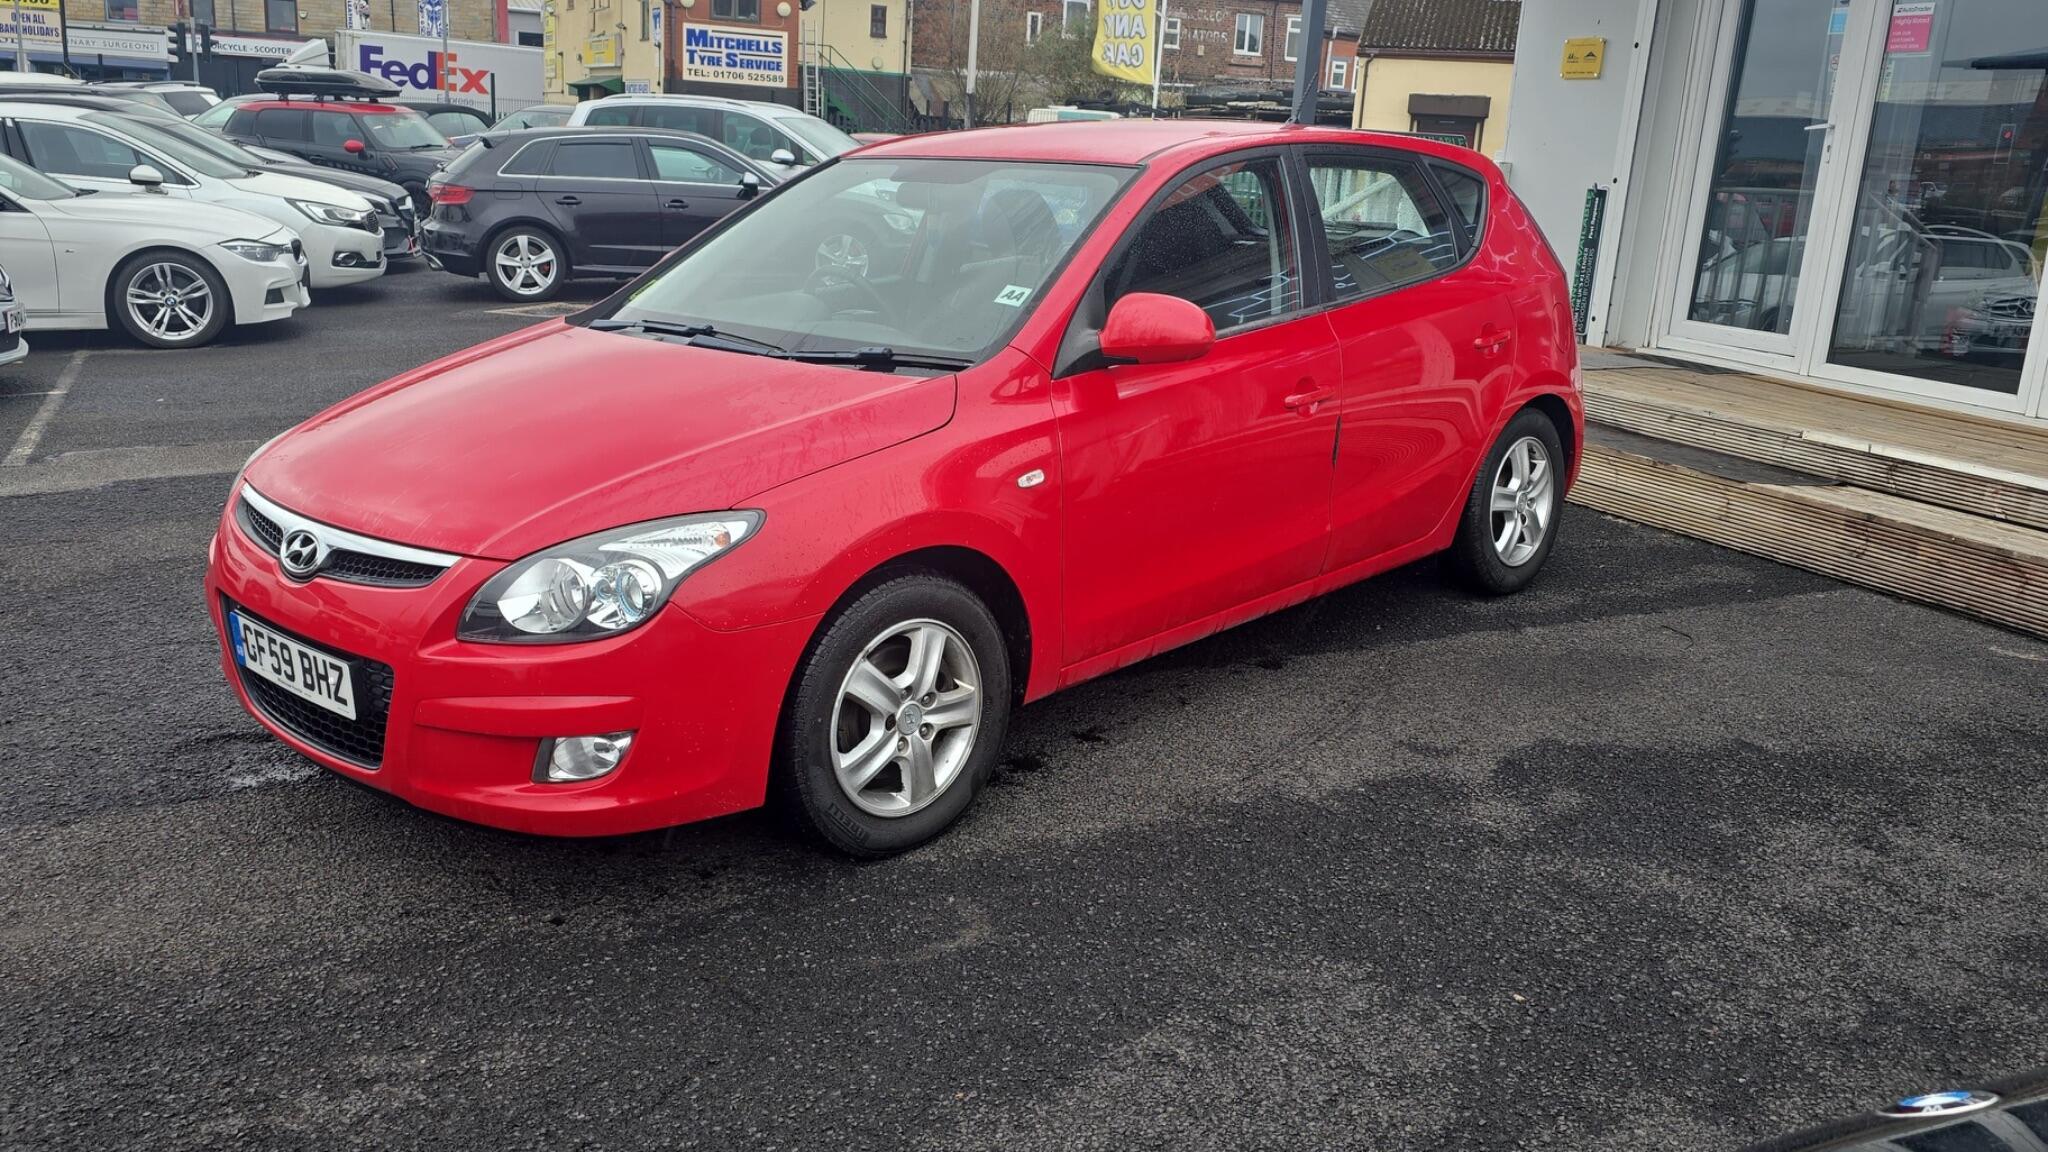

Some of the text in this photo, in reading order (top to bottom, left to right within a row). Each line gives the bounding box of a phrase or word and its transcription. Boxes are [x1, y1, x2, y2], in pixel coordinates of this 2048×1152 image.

[11, 12, 46, 24] OEN ALL
[0, 23, 60, 37] BAN HOLIDAYS
[102, 40, 155, 51] SURGEONS
[686, 28, 783, 54] MITCHELLS
[686, 49, 782, 71] TYRE SERVICE
[360, 45, 489, 94] FedEx
[687, 68, 784, 83] TEL: 01706 525589
[1000, 290, 1025, 301] AA
[242, 623, 348, 706] GF59 BHZ
